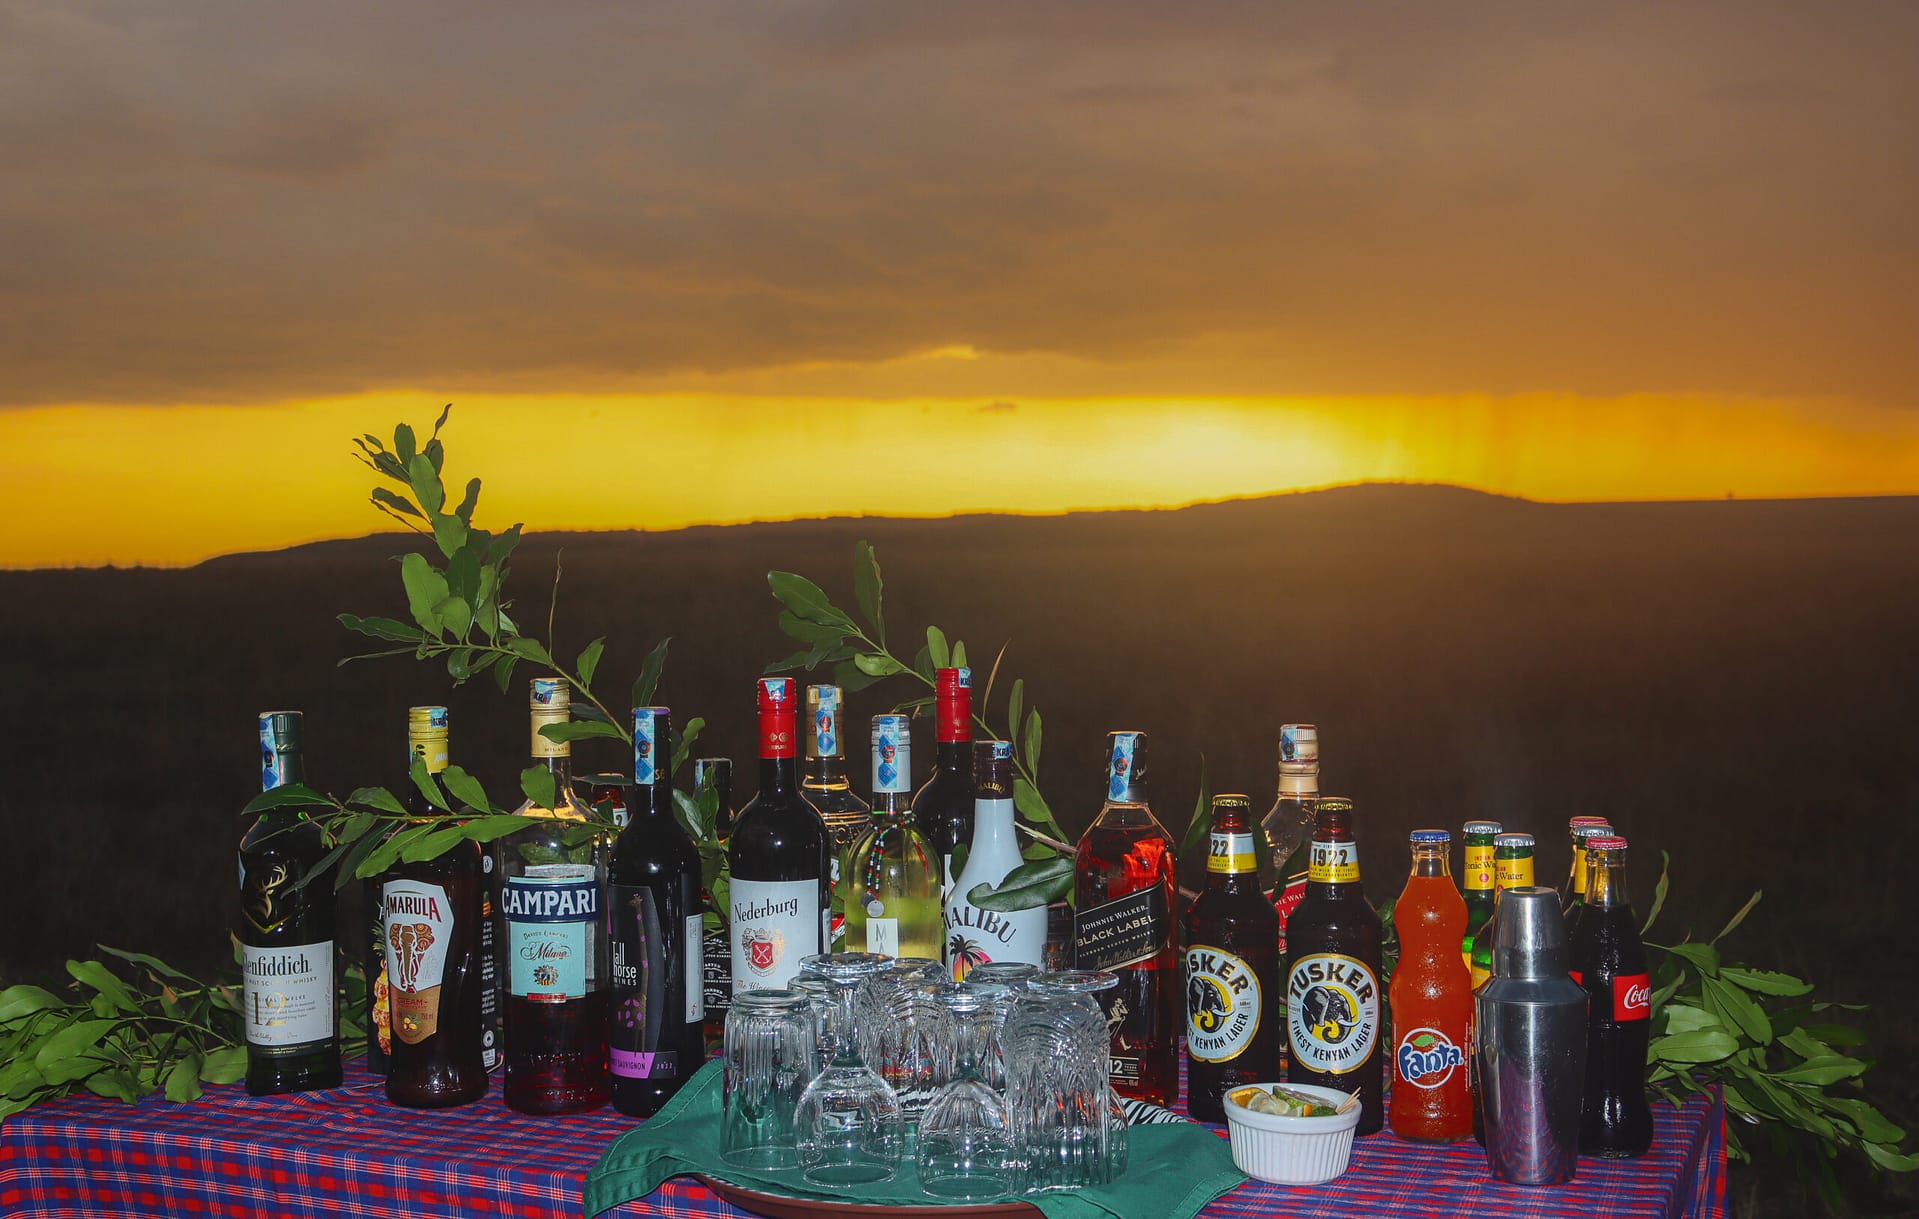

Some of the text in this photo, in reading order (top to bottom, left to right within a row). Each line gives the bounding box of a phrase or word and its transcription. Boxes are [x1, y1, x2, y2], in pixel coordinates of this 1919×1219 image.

[1312, 848, 1349, 867] 1922
[1499, 872, 1524, 880] Water
[386, 893, 443, 923] AMARULA
[502, 887, 597, 916] CAMPARI
[734, 897, 799, 924] Nederburg
[1077, 915, 1157, 947] BLACK LABEL
[1082, 904, 1147, 933] JOHNNIE WALKER
[243, 953, 309, 977] lenfiddich
[612, 941, 625, 965] Tall
[613, 965, 637, 979] horse
[613, 977, 637, 986] WINES
[1186, 952, 1249, 995] USKER
[1289, 962, 1374, 1005] TUSKER
[252, 991, 287, 1027] 12
[1194, 1012, 1249, 1051] KENYAN LAGER
[1291, 1018, 1313, 1052] FINEST
[1312, 1046, 1352, 1062] KENYAN
[1350, 1022, 1373, 1053] LAGER
[1109, 1059, 1123, 1074] 12
[1398, 1042, 1462, 1082] Fanta
